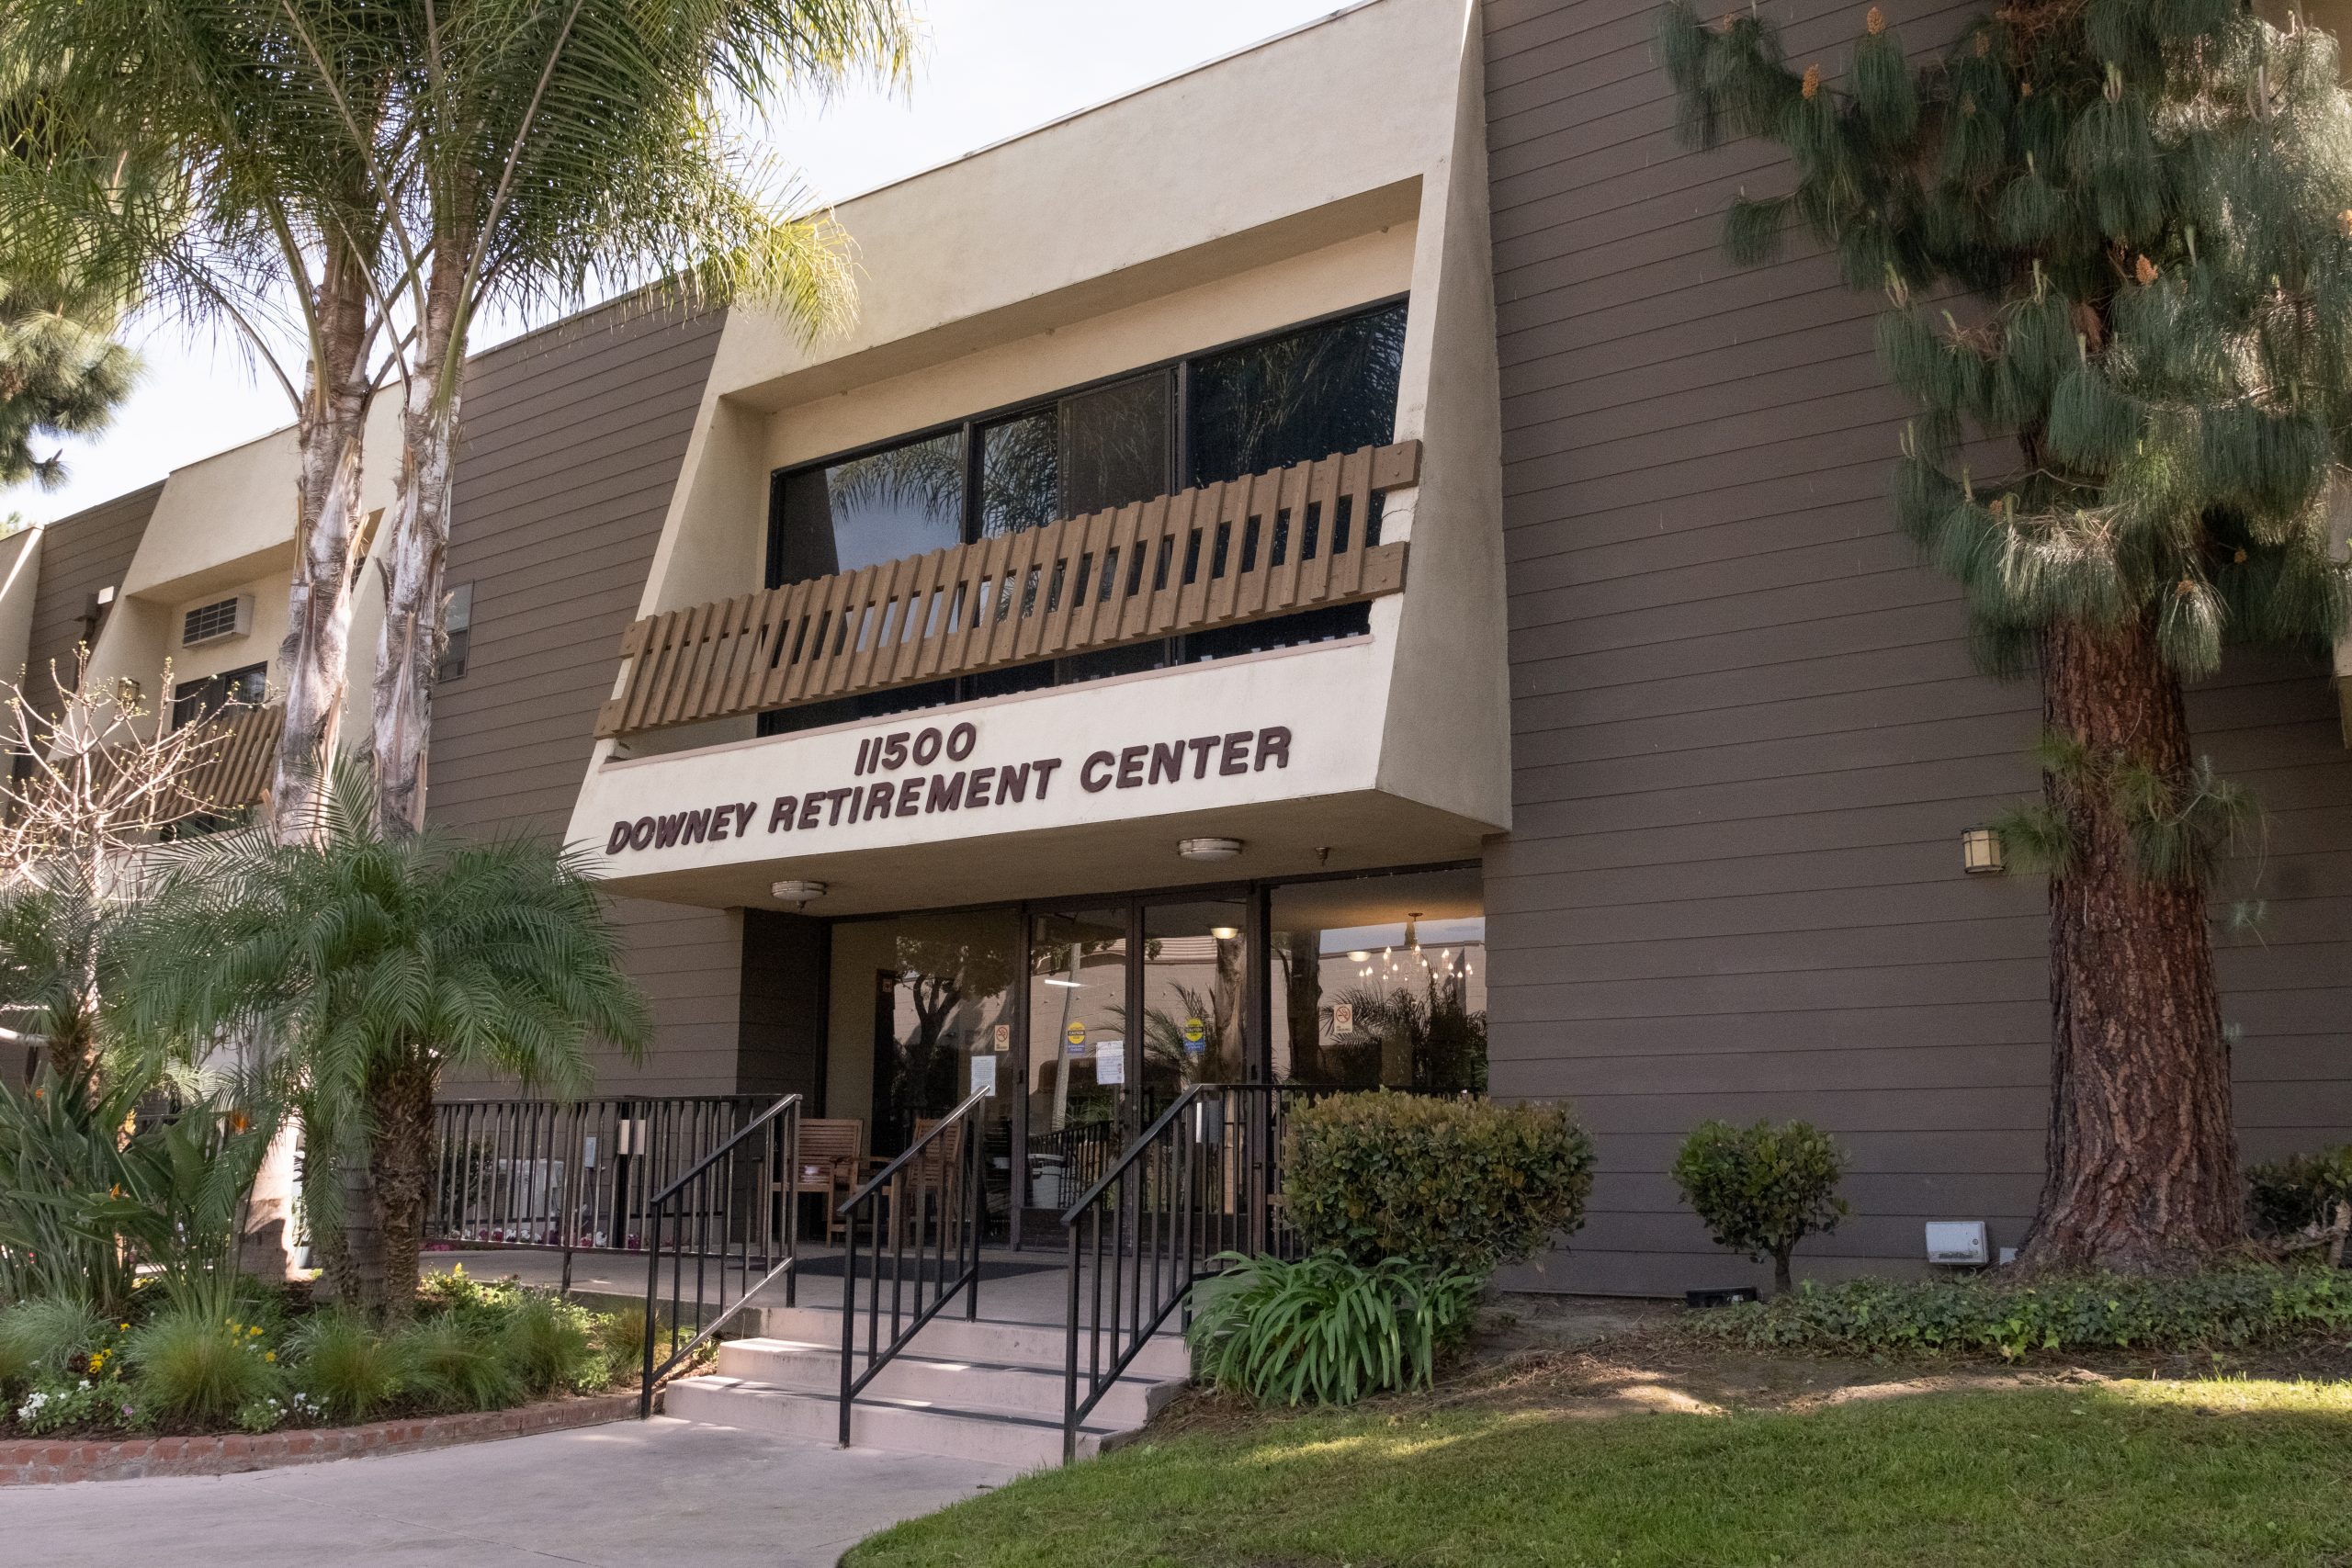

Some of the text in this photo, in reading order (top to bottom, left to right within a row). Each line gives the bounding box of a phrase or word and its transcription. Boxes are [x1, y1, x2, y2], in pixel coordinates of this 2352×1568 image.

[605, 726, 1292, 855] DOWNEY RETIREMENT CENTER
[854, 722, 977, 776] 11500
